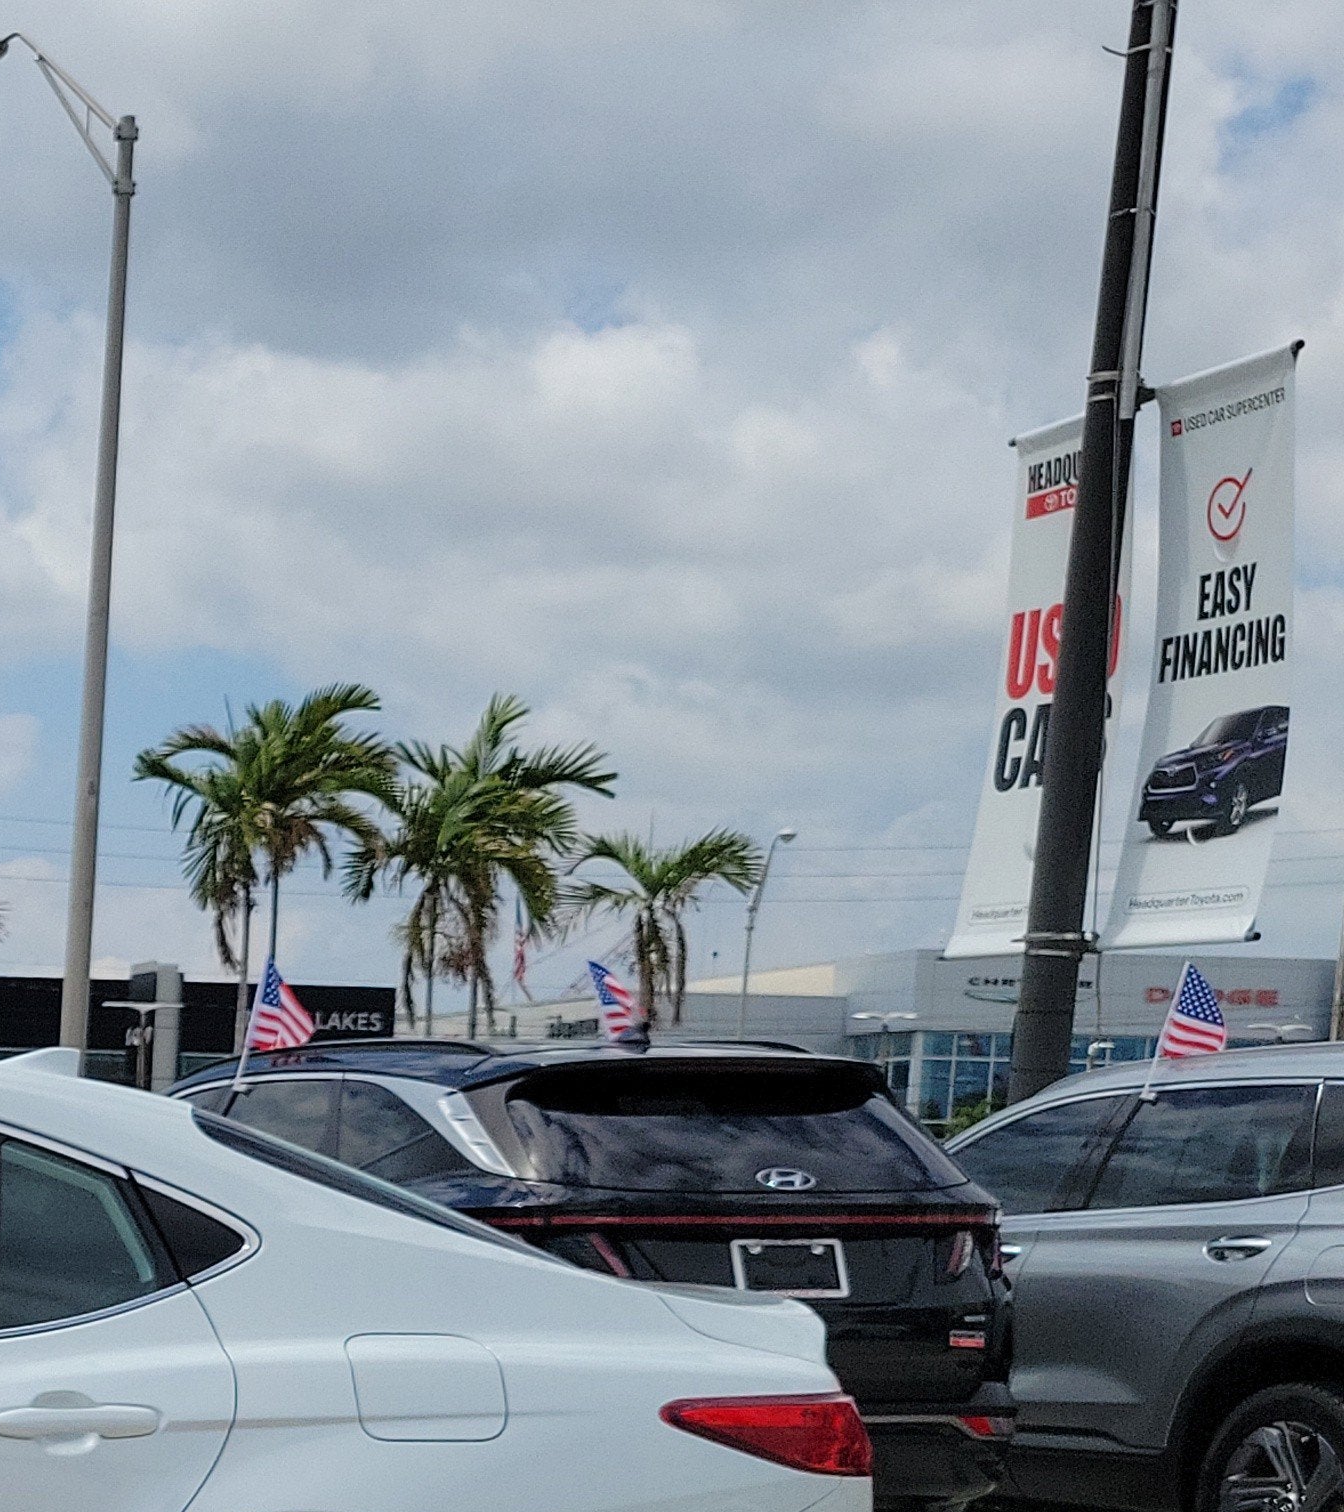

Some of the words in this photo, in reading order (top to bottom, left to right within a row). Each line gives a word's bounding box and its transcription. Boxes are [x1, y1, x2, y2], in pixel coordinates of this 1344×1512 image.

[1183, 413, 1207, 433] USED
[1209, 406, 1226, 426] CAR
[1027, 450, 1081, 494] HEADQU
[1197, 562, 1257, 620] EASY
[1158, 613, 1286, 683] FINANCING
[314, 1011, 383, 1032] LAKES
